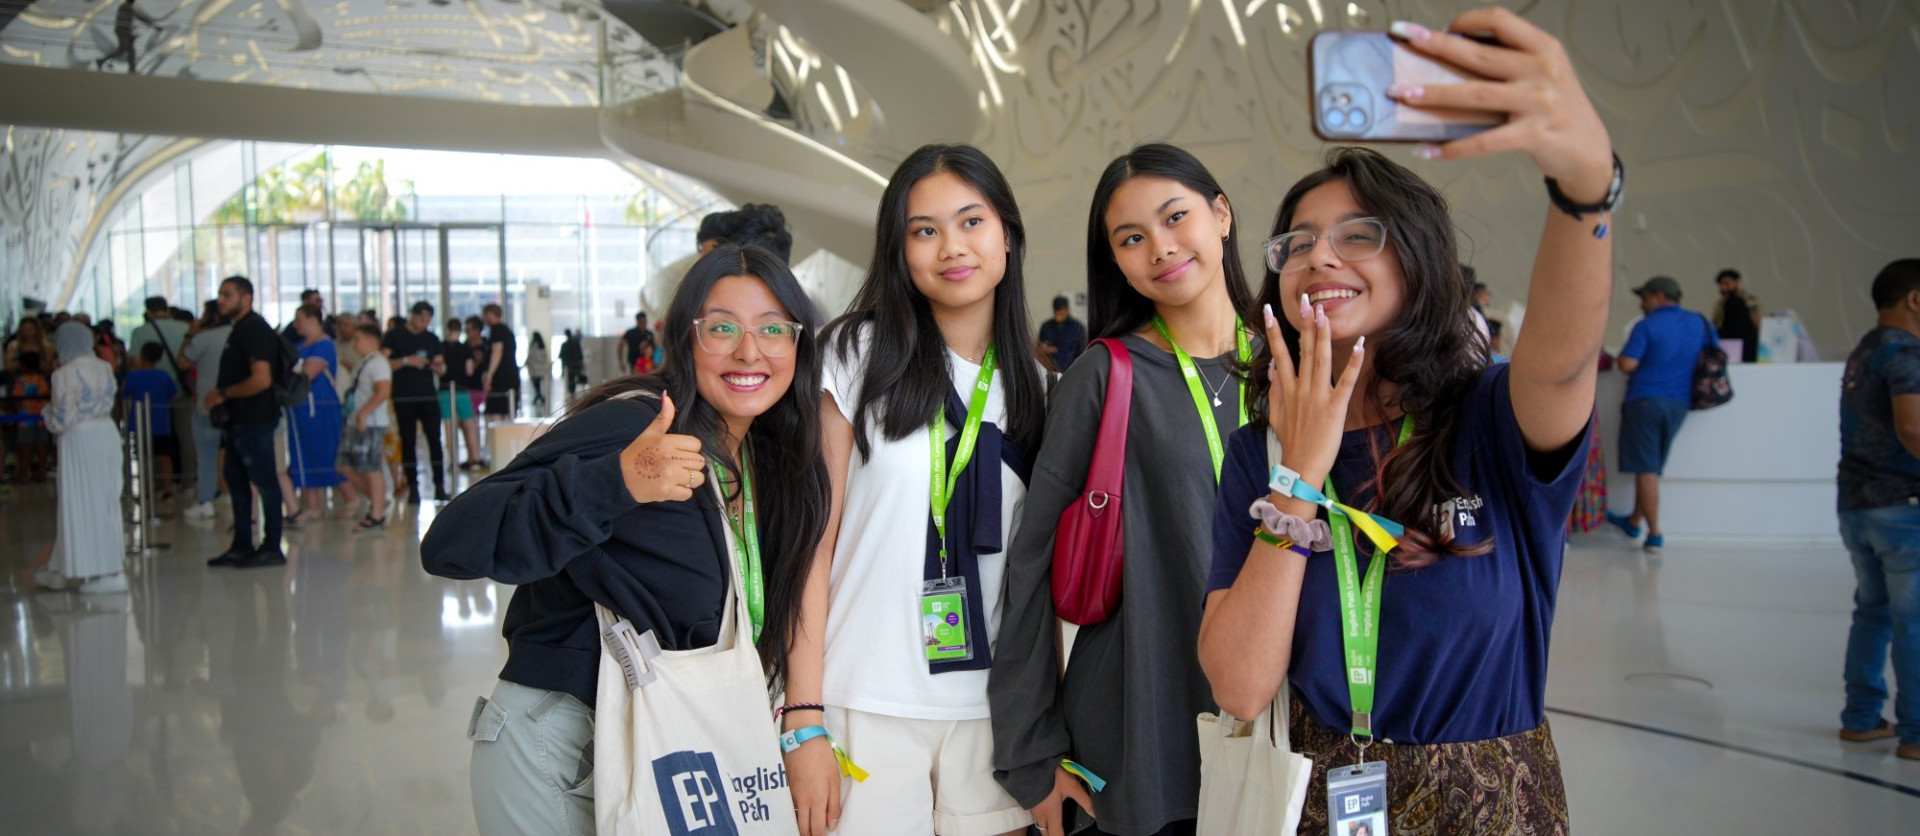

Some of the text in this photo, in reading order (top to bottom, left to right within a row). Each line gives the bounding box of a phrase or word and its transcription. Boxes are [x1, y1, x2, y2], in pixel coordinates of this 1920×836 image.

[1343, 554, 1354, 590] Language
[1347, 591, 1355, 608] Path
[1364, 590, 1373, 608] Path
[1349, 609, 1359, 637] English
[729, 763, 789, 800] nglish
[671, 771, 719, 832] EP
